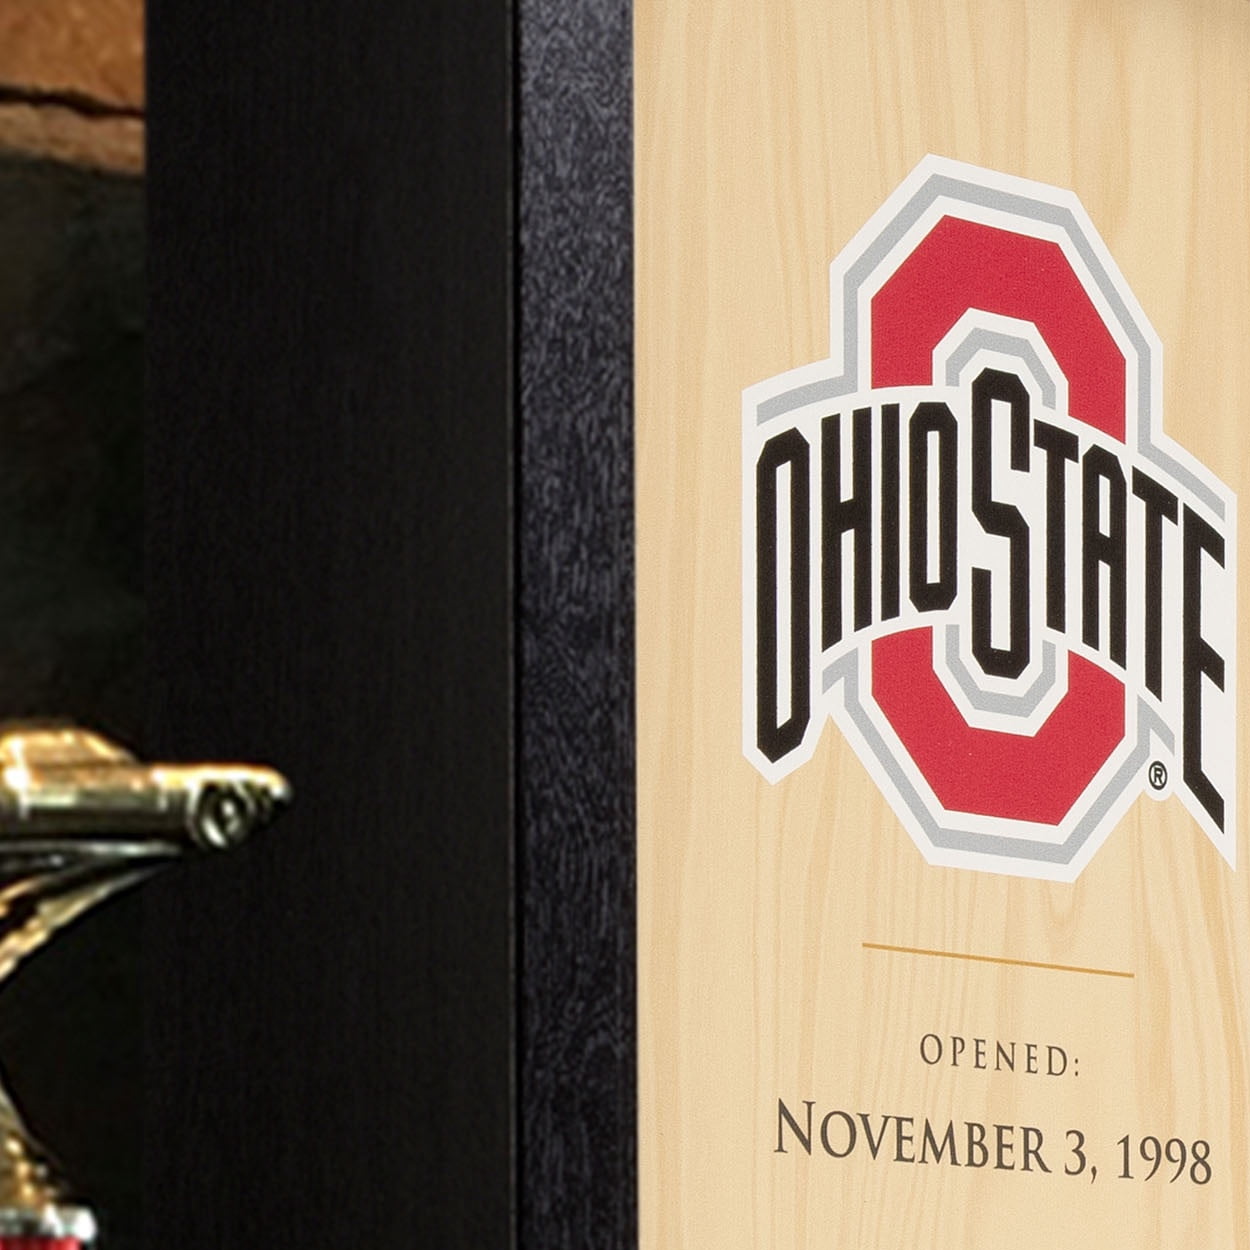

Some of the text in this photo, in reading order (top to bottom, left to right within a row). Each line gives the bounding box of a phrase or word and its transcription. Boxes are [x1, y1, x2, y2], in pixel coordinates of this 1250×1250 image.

[756, 366, 1226, 835] OHIO STATE
[919, 1033, 1080, 1078] OPENED:
[773, 1097, 1213, 1186] NOVEMBER 3, 1998
